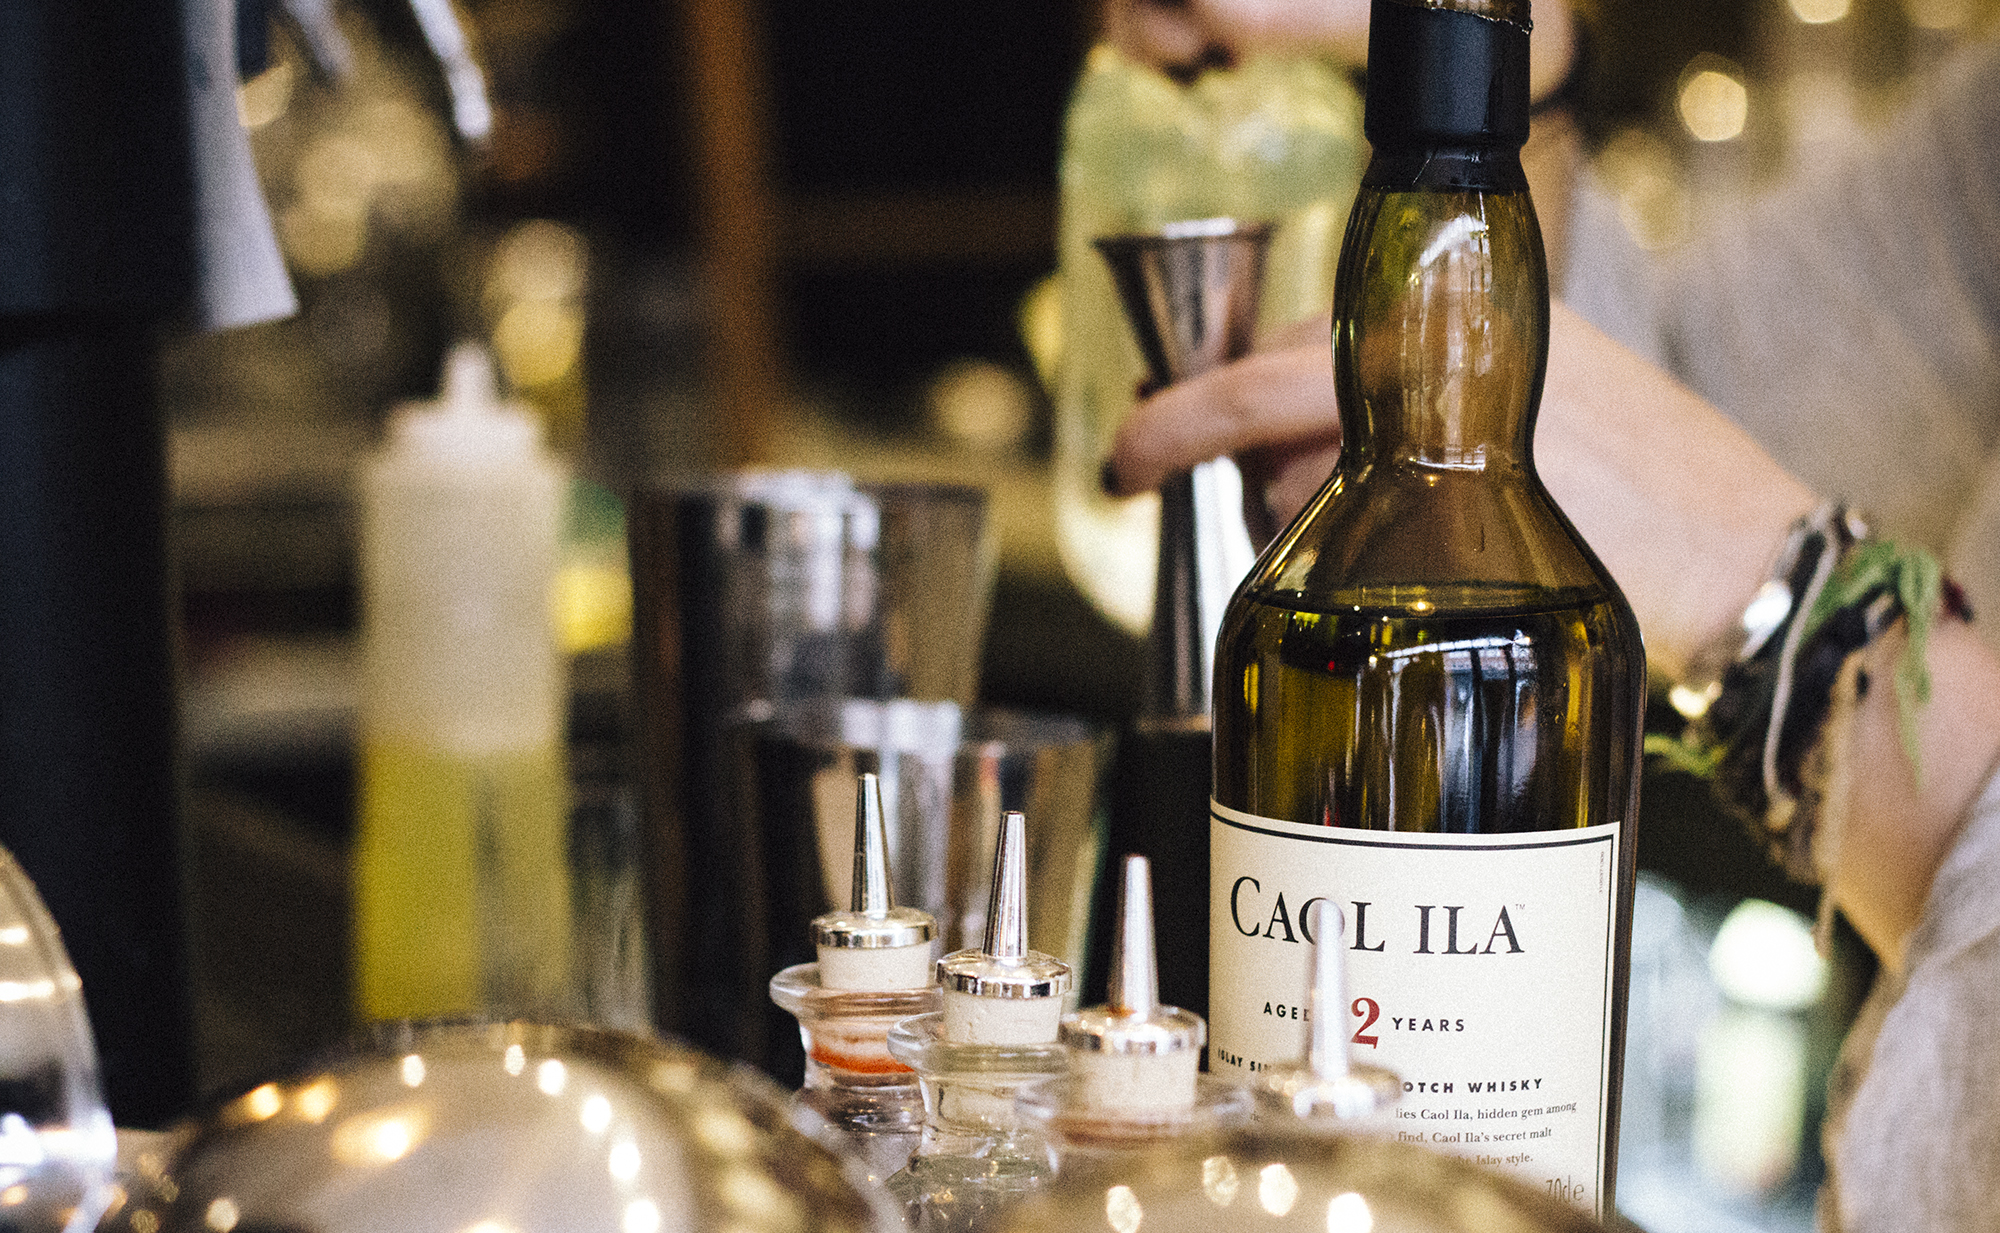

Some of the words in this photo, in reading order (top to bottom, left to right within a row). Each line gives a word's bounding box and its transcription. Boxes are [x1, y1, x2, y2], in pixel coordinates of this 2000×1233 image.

[1230, 876, 1386, 952] CAOL
[1351, 997, 1380, 1049] 2
[1392, 1017, 1465, 1032] YEARS
[1217, 1048, 1244, 1068] ISLAY
[1402, 1081, 1454, 1094] OTCH
[1468, 1078, 1543, 1093] WHISKY
[1420, 1109, 1450, 1120] Caol
[1453, 1109, 1474, 1121] Ila,
[1477, 1108, 1518, 1119] hidden
[1521, 1107, 1543, 1119] gem
[1546, 1102, 1577, 1114] among
[1398, 1130, 1428, 1144] find,
[1432, 1132, 1461, 1144] Caol
[1493, 1130, 1527, 1142] secret
[1529, 1127, 1552, 1139] malt
[1506, 1152, 1534, 1167] style.
